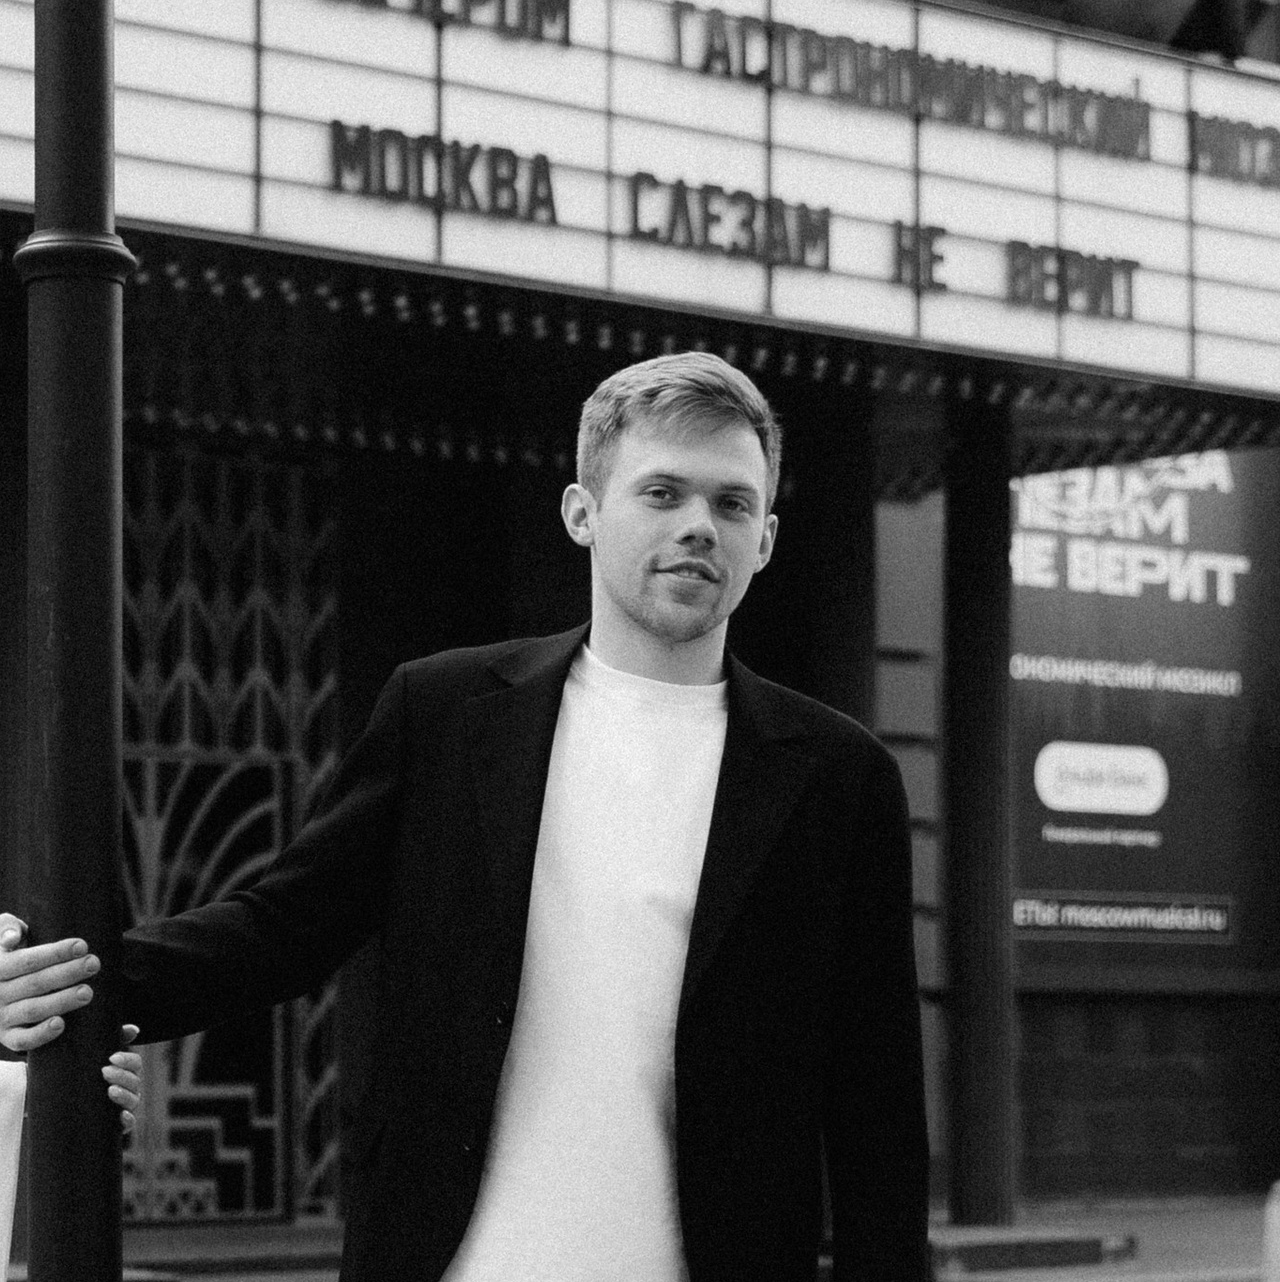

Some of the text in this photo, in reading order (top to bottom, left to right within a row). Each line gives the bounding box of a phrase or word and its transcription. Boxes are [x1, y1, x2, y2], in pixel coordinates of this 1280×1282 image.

[330, 119, 1141, 321] МОСКВА СЛЕЗАМ НЕ ВЕРИТ
[1066, 536, 1252, 608] ВЕРИТ
